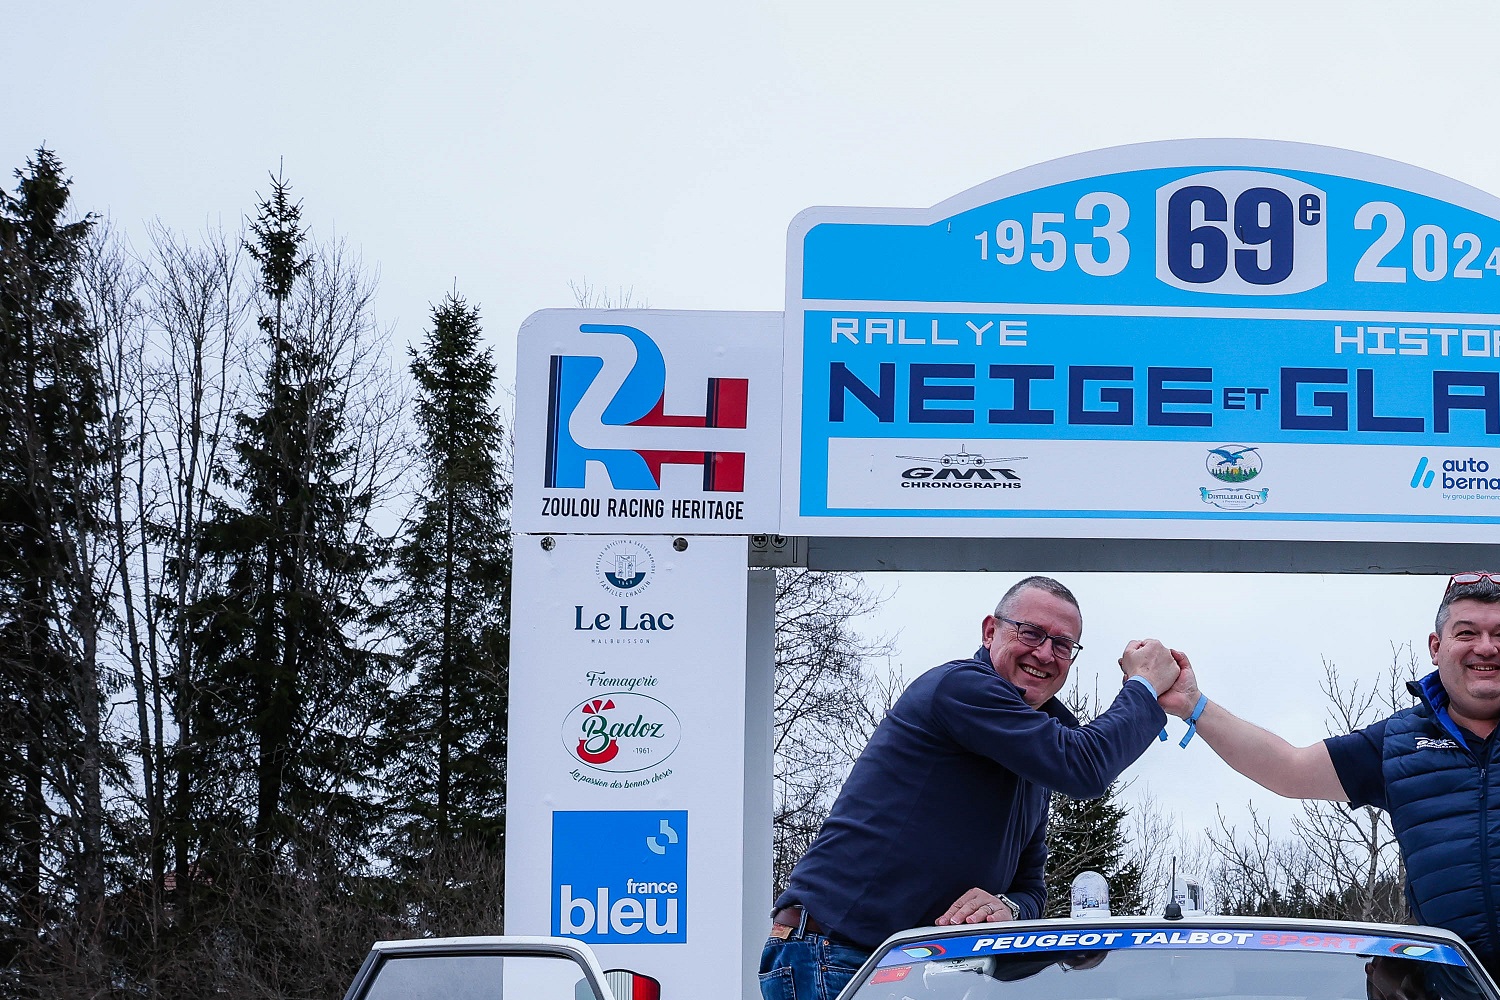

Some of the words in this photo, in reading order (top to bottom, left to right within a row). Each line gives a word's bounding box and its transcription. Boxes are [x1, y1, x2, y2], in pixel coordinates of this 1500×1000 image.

[974, 192, 1130, 276] 1953
[831, 318, 1028, 346] RALLYE
[829, 362, 1212, 426] NEIGE
[1223, 387, 1269, 410] ET
[901, 467, 1021, 480] GMT
[1442, 458, 1489, 472] auto
[542, 498, 600, 517] ZOULOU
[608, 499, 664, 518] RACING
[672, 500, 744, 520] HERITAGE
[574, 606, 610, 630] Le
[620, 606, 674, 630] Lac
[586, 670, 659, 690] Fromagerie
[582, 715, 664, 754] Badoz
[570, 768, 580, 781] La
[579, 774, 608, 788] passion
[610, 778, 622, 788] des
[624, 777, 650, 788] bonnes
[652, 768, 673, 782] choses
[627, 878, 678, 894] france
[560, 885, 678, 934] bleu
[972, 933, 1122, 952] PEUGEOT
[1131, 932, 1254, 946] TALBOT
[1262, 933, 1365, 949] SPORT
